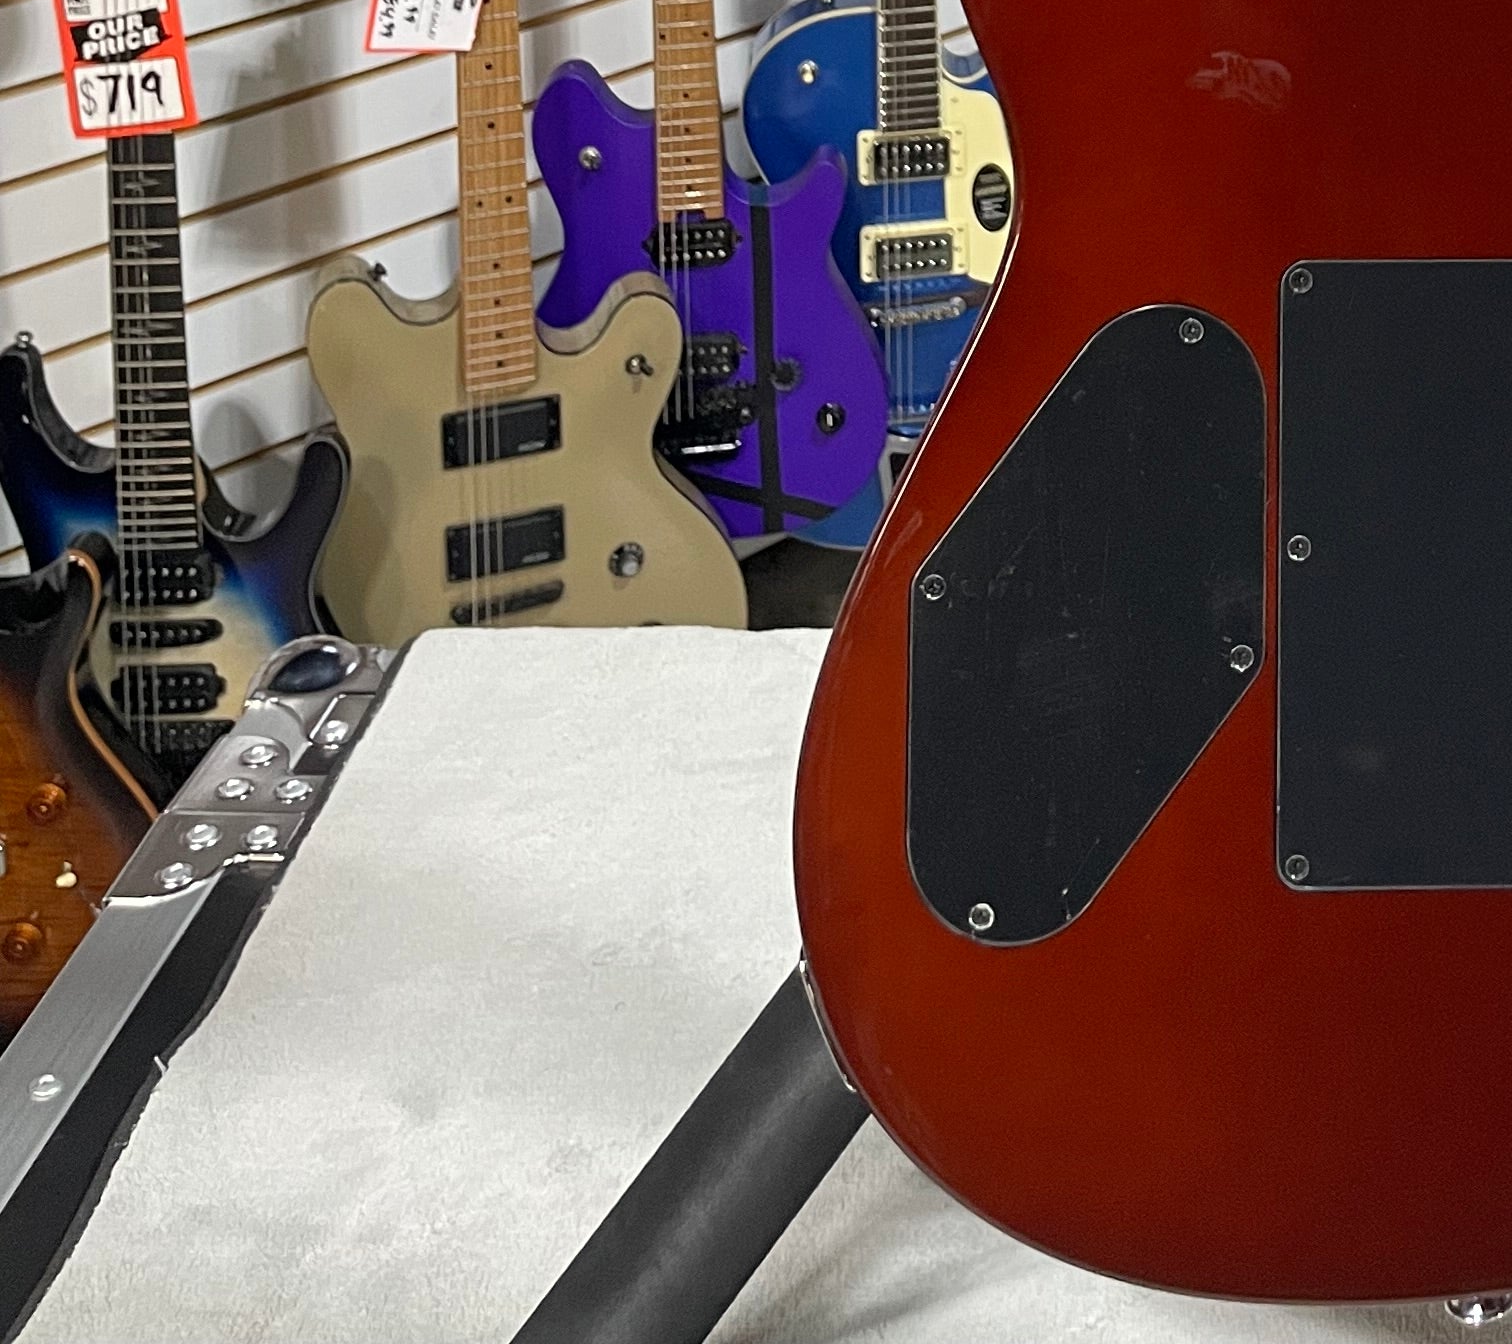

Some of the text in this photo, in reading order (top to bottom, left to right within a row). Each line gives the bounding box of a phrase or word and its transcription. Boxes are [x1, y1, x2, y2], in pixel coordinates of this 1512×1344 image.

[82, 25, 161, 60] PRICE
[87, 13, 145, 40] OUR
[80, 70, 164, 116] $719
